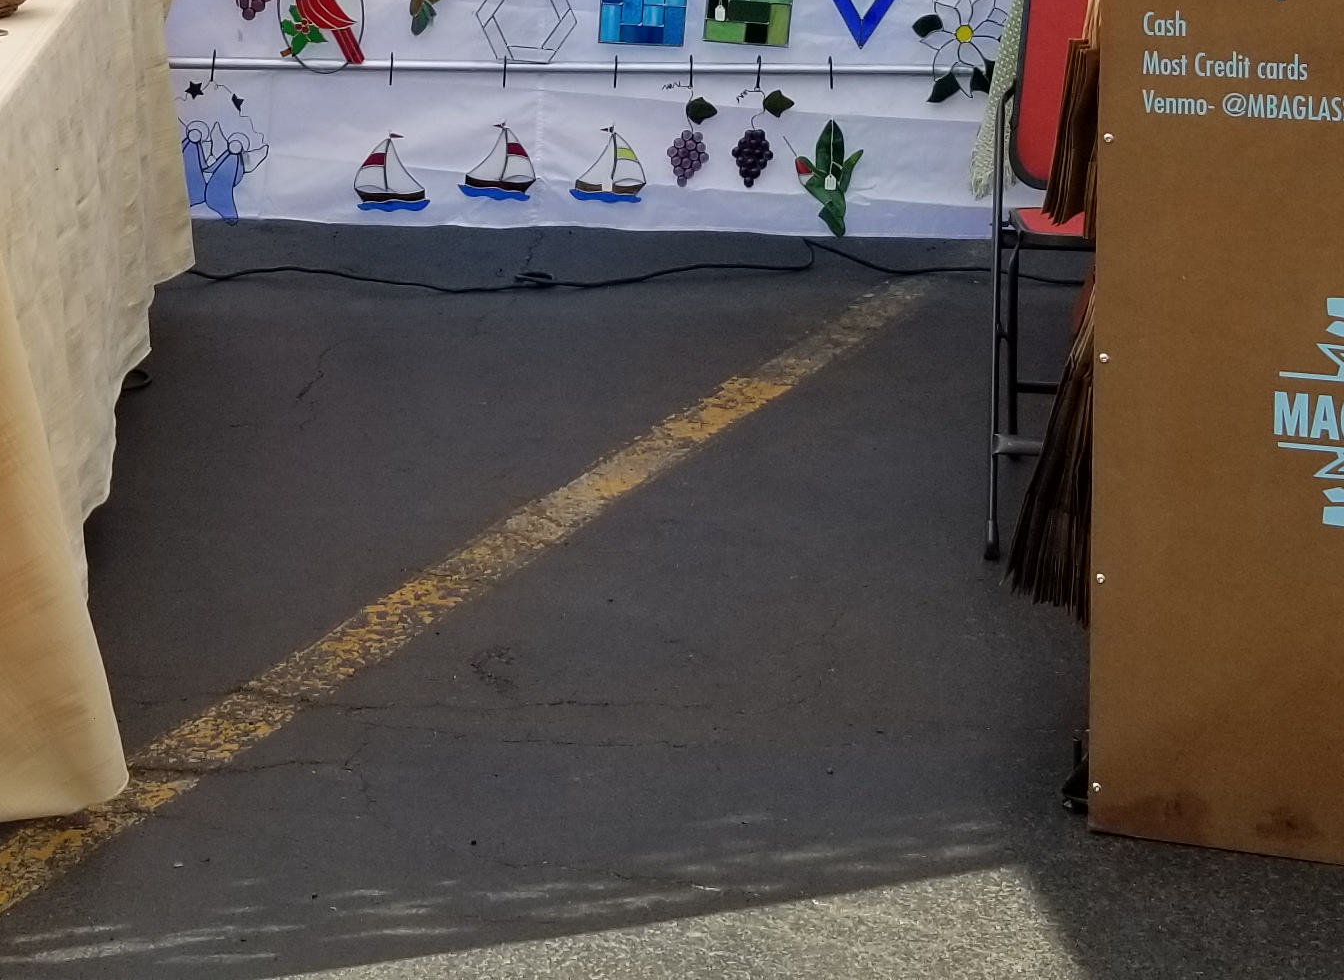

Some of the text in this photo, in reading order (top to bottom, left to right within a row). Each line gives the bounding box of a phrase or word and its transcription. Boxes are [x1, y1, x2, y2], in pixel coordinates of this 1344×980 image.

[1143, 10, 1187, 37] Cash
[1142, 50, 1308, 81] Most Credit cards
[1142, 89, 1215, 115] Venmo-
